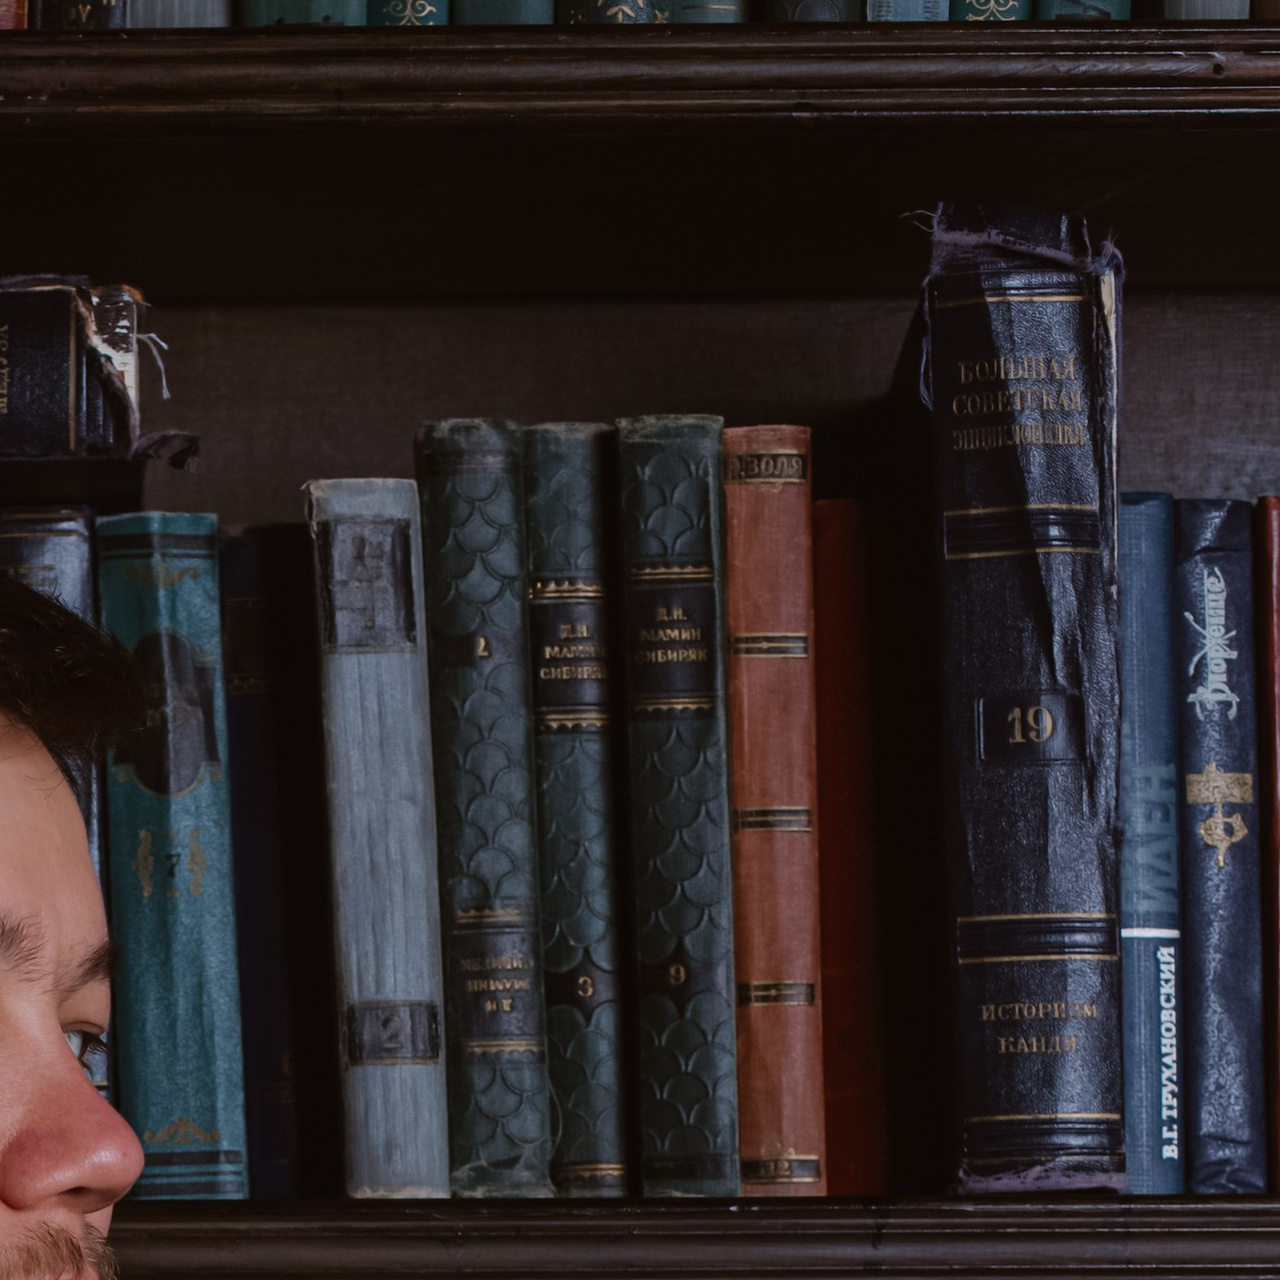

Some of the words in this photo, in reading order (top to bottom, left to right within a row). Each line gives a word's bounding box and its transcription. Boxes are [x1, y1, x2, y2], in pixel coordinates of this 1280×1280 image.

[958, 356, 1077, 384] БОЛЬШАЯ
[952, 389, 1082, 416] СОВЕТСКАЯ
[953, 424, 1085, 451] ЭНЦИКЛОПЕДИЯ
[656, 608, 687, 622] Д.Н.
[477, 636, 490, 656] 7
[640, 627, 702, 642] МАМИН
[544, 645, 607, 660] МАМИН
[635, 648, 709, 663] СИБИРЯК
[1007, 705, 1055, 744] 19
[165, 853, 181, 877] 7
[577, 975, 594, 997] 3
[668, 963, 687, 986] 9
[1156, 946, 1178, 1120] ТРУХАНОВСКИЙ
[1161, 1124, 1179, 1160] В.Г.
